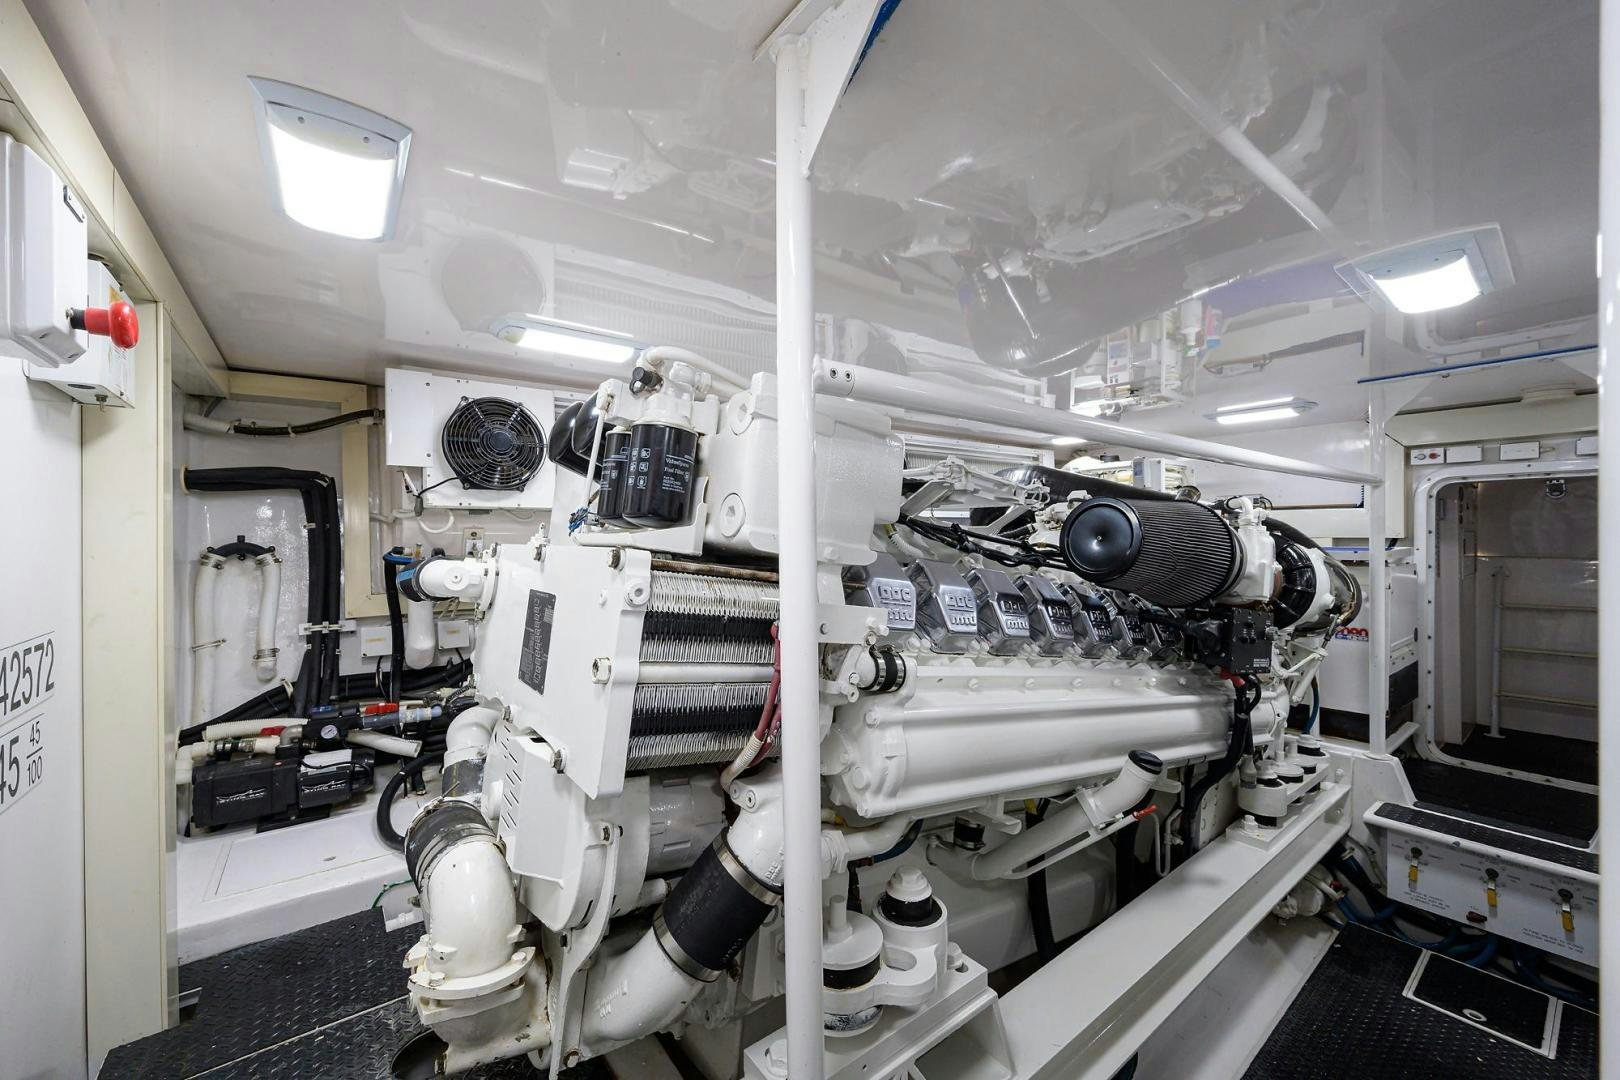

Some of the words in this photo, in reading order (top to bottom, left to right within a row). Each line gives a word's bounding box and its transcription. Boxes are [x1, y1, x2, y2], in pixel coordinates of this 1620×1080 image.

[0, 638, 54, 716] 42572
[29, 720, 41, 747] 45
[26, 755, 43, 787] 100
